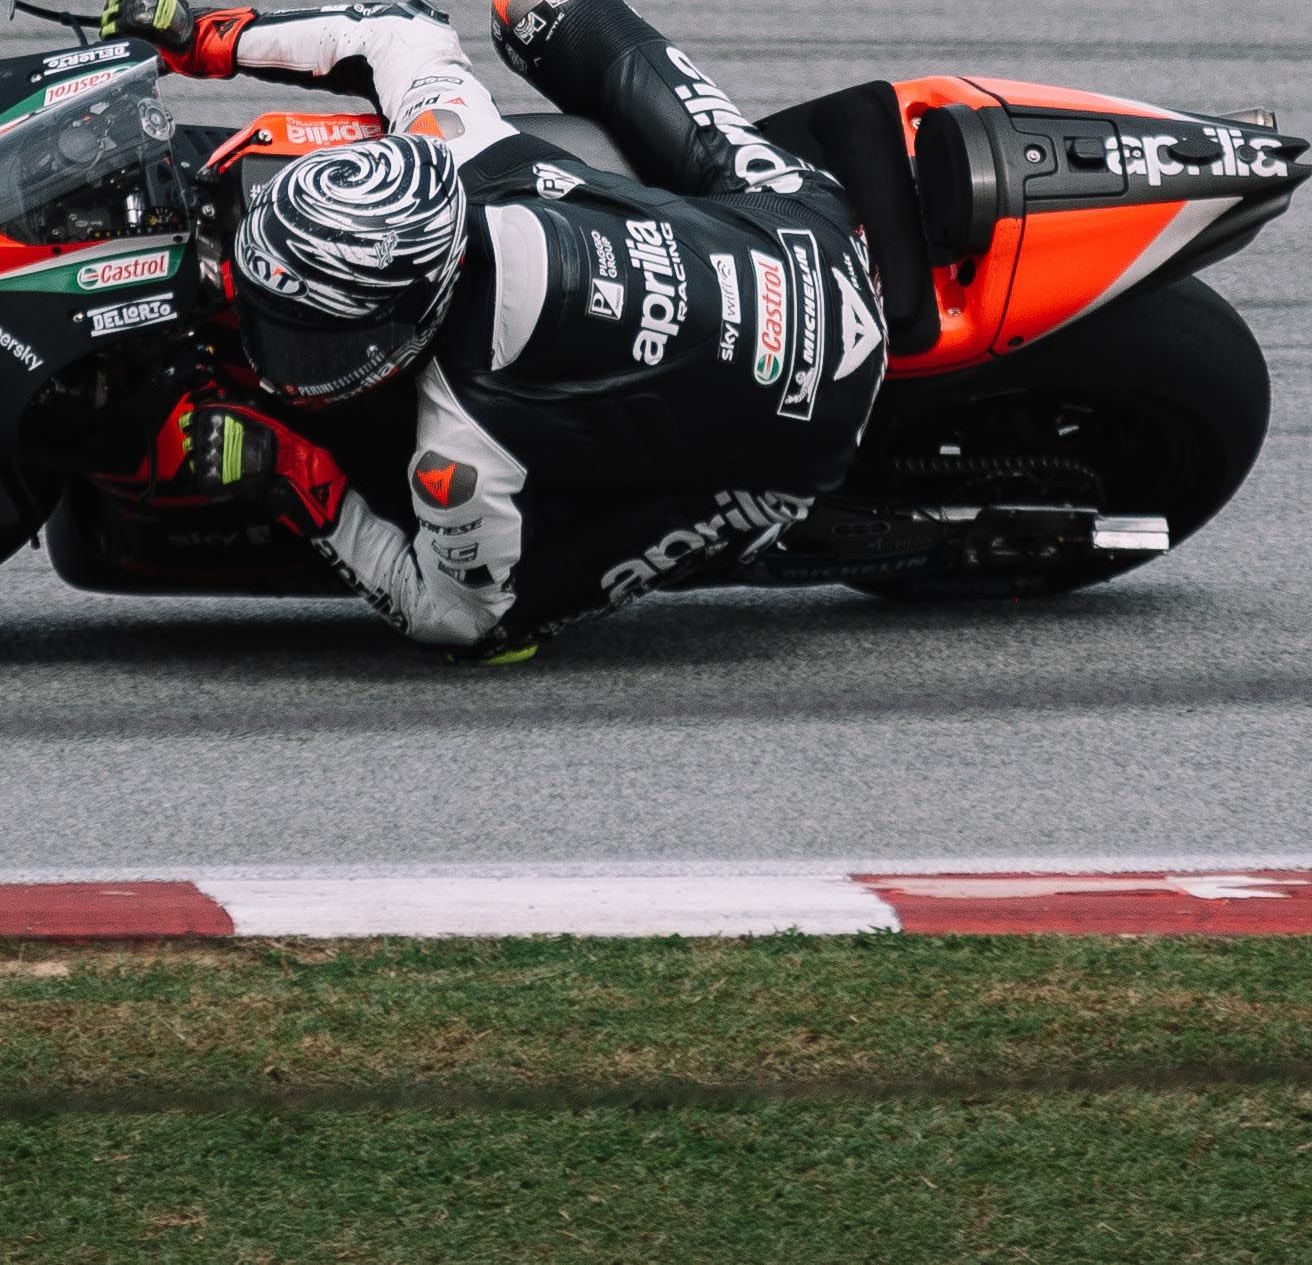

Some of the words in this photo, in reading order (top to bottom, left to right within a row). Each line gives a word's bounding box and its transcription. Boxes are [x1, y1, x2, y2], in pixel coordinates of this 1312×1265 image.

[48, 71, 113, 103] Castrol
[100, 255, 166, 284] Castrol
[591, 229, 608, 277] PIAGGIO
[601, 236, 618, 279] GROUP
[660, 221, 688, 322] RACING
[625, 219, 680, 366] aprilia
[757, 261, 782, 353] Castrol
[792, 245, 816, 364] MICHELIN
[720, 323, 739, 362] sky
